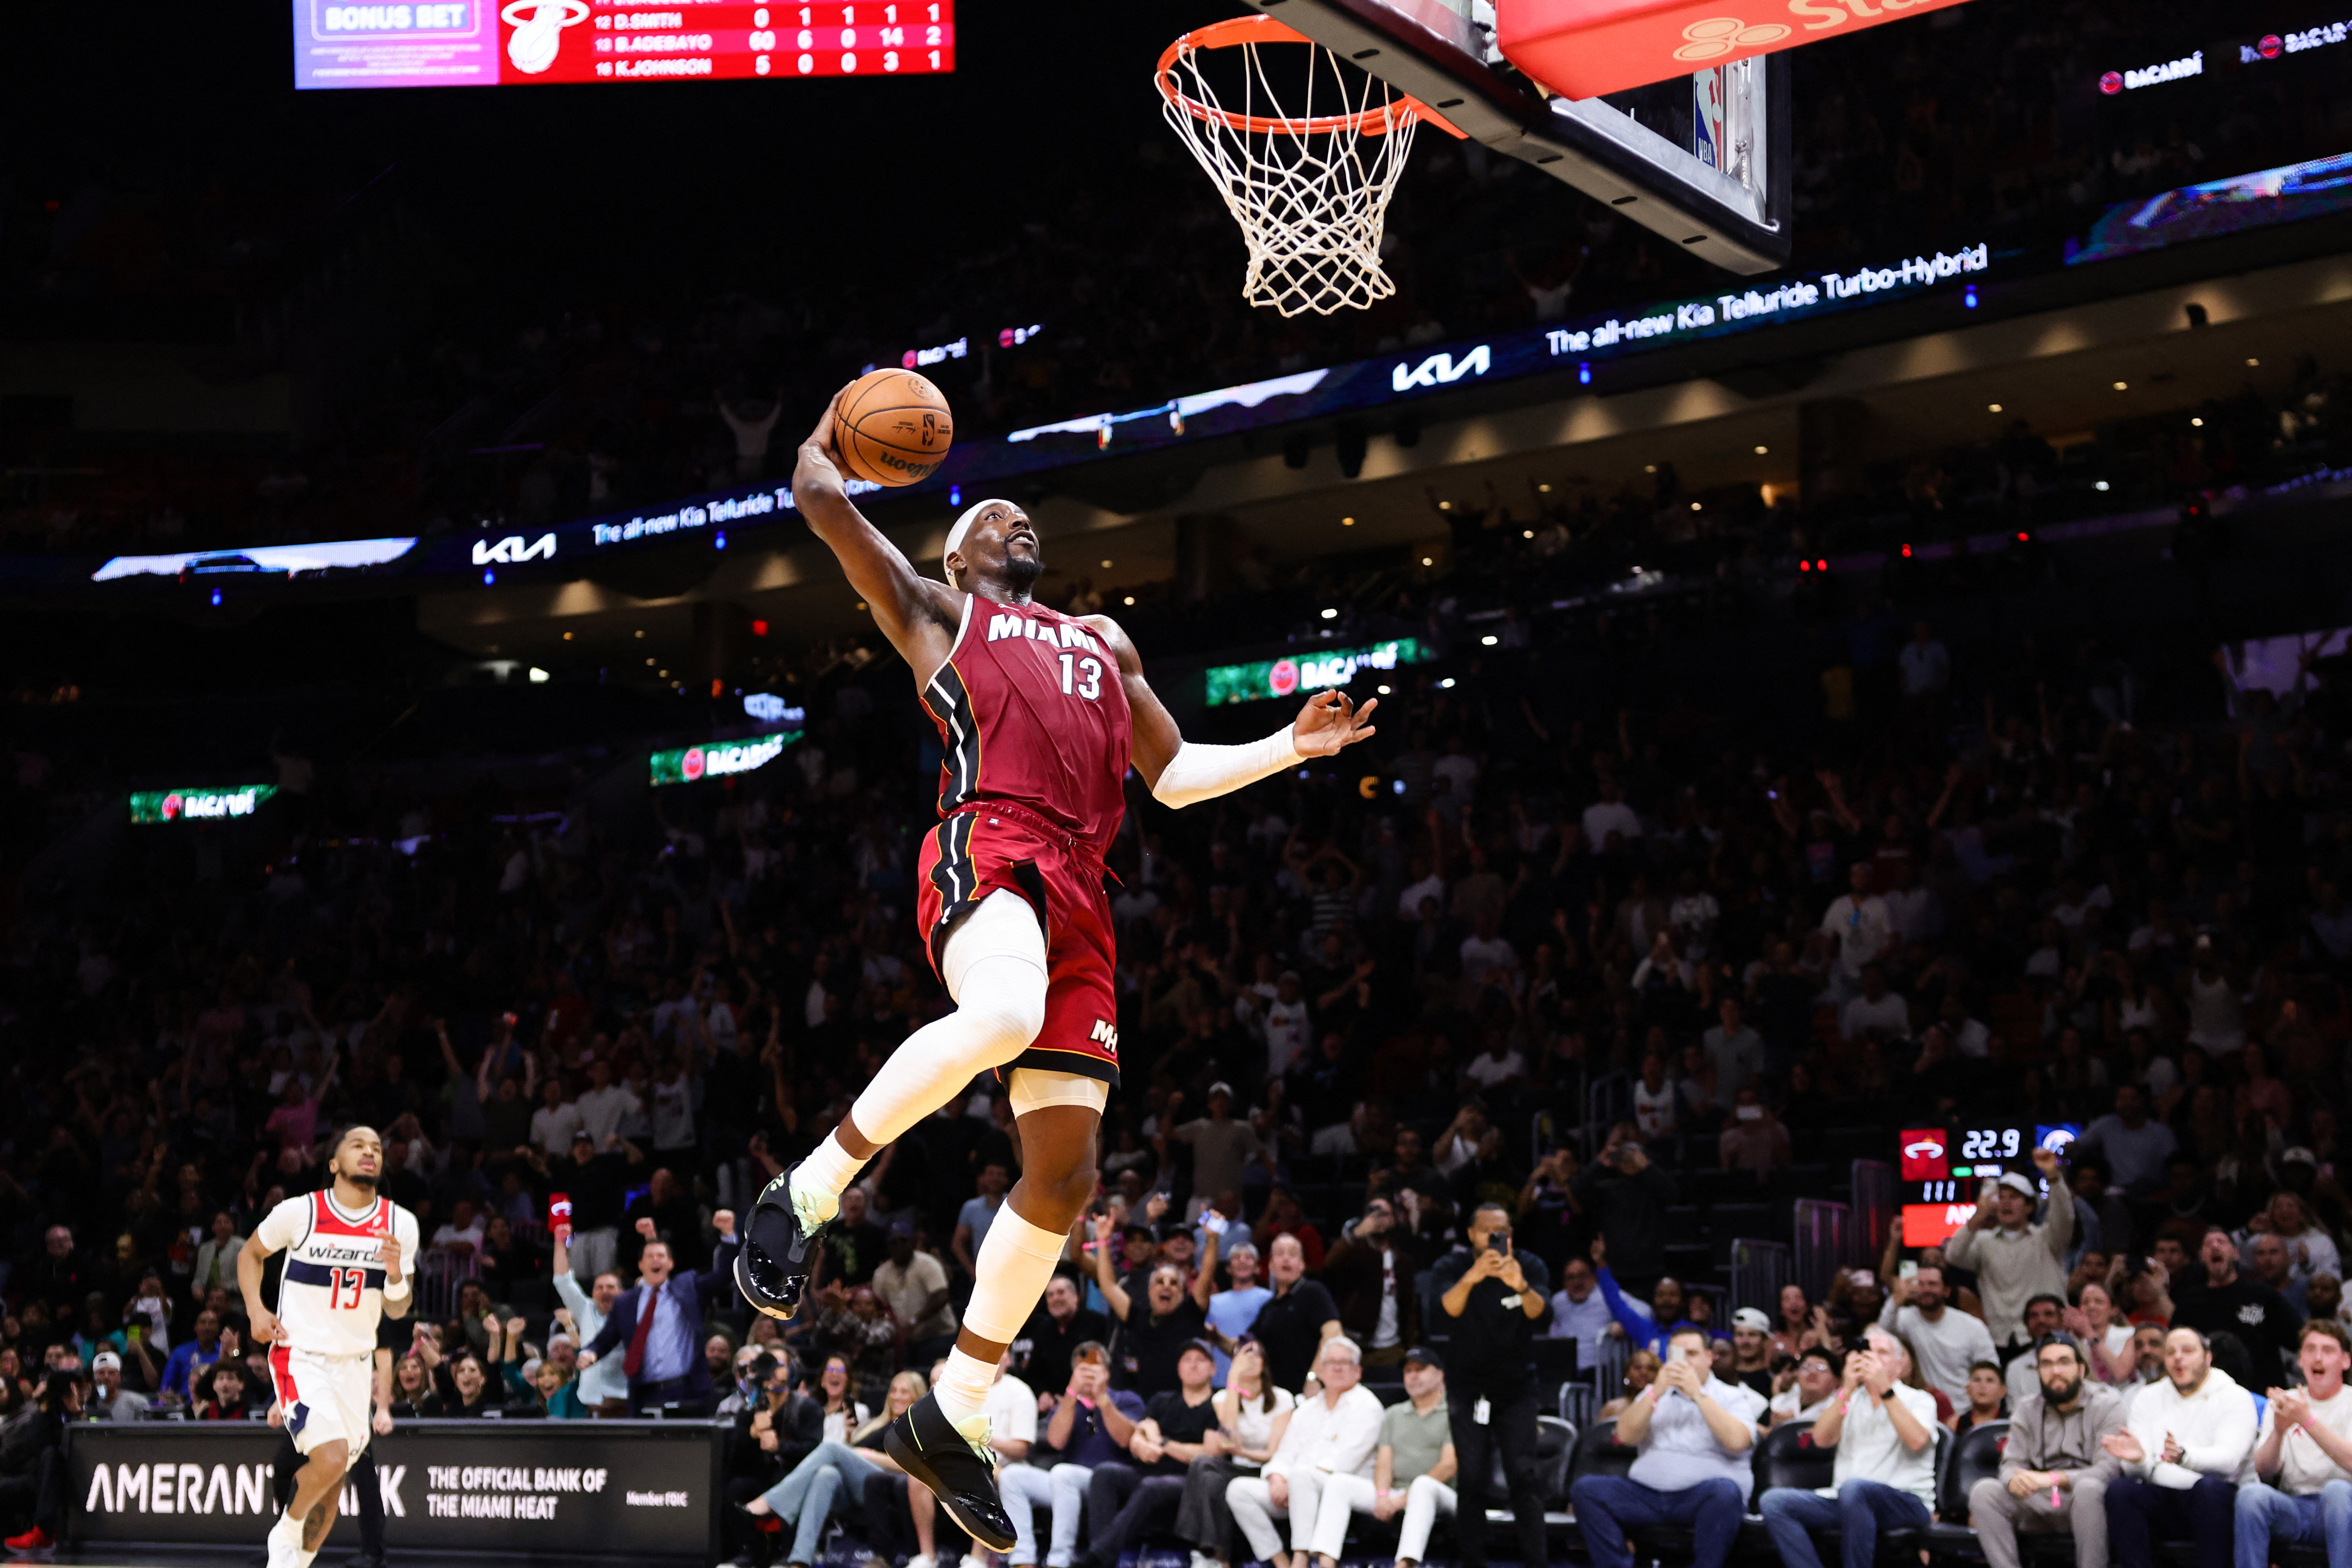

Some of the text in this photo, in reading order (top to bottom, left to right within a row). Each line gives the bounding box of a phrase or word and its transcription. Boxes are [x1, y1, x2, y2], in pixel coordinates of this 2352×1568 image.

[326, 4, 465, 31] BONUS BET
[754, 8, 770, 28] 0
[799, 7, 811, 27] 1
[842, 5, 854, 25] 1
[884, 4, 897, 25] 1
[927, 3, 940, 23] 1
[749, 30, 776, 51] 60
[797, 29, 813, 50] 6
[841, 28, 856, 49] 0
[879, 27, 904, 47] 14
[926, 25, 941, 46] 2
[755, 55, 771, 75] 5
[798, 53, 813, 74] 0
[841, 52, 857, 73] 0
[883, 51, 899, 72] 3
[928, 49, 940, 70] 1
[1698, 137, 1712, 165] NBA
[1546, 330, 1590, 356] The
[1593, 313, 1675, 348] all-new
[1678, 303, 1715, 330] Kia
[1717, 281, 1819, 321] Telluride
[1821, 242, 1987, 300] Turbo-Hybrid
[680, 506, 706, 529] Kia
[987, 613, 1102, 656] MIAMI
[1058, 653, 1103, 702] 13
[1962, 1129, 2020, 1159] 22.9
[1923, 1180, 1956, 1203] 111
[330, 1267, 367, 1309] 13
[86, 1462, 279, 1515] AMERAN
[427, 1466, 607, 1493] THE OFFICIAL BANK OF
[427, 1494, 558, 1520] THE MIAMI HEAT
[626, 1490, 689, 1507] Member FDIC
